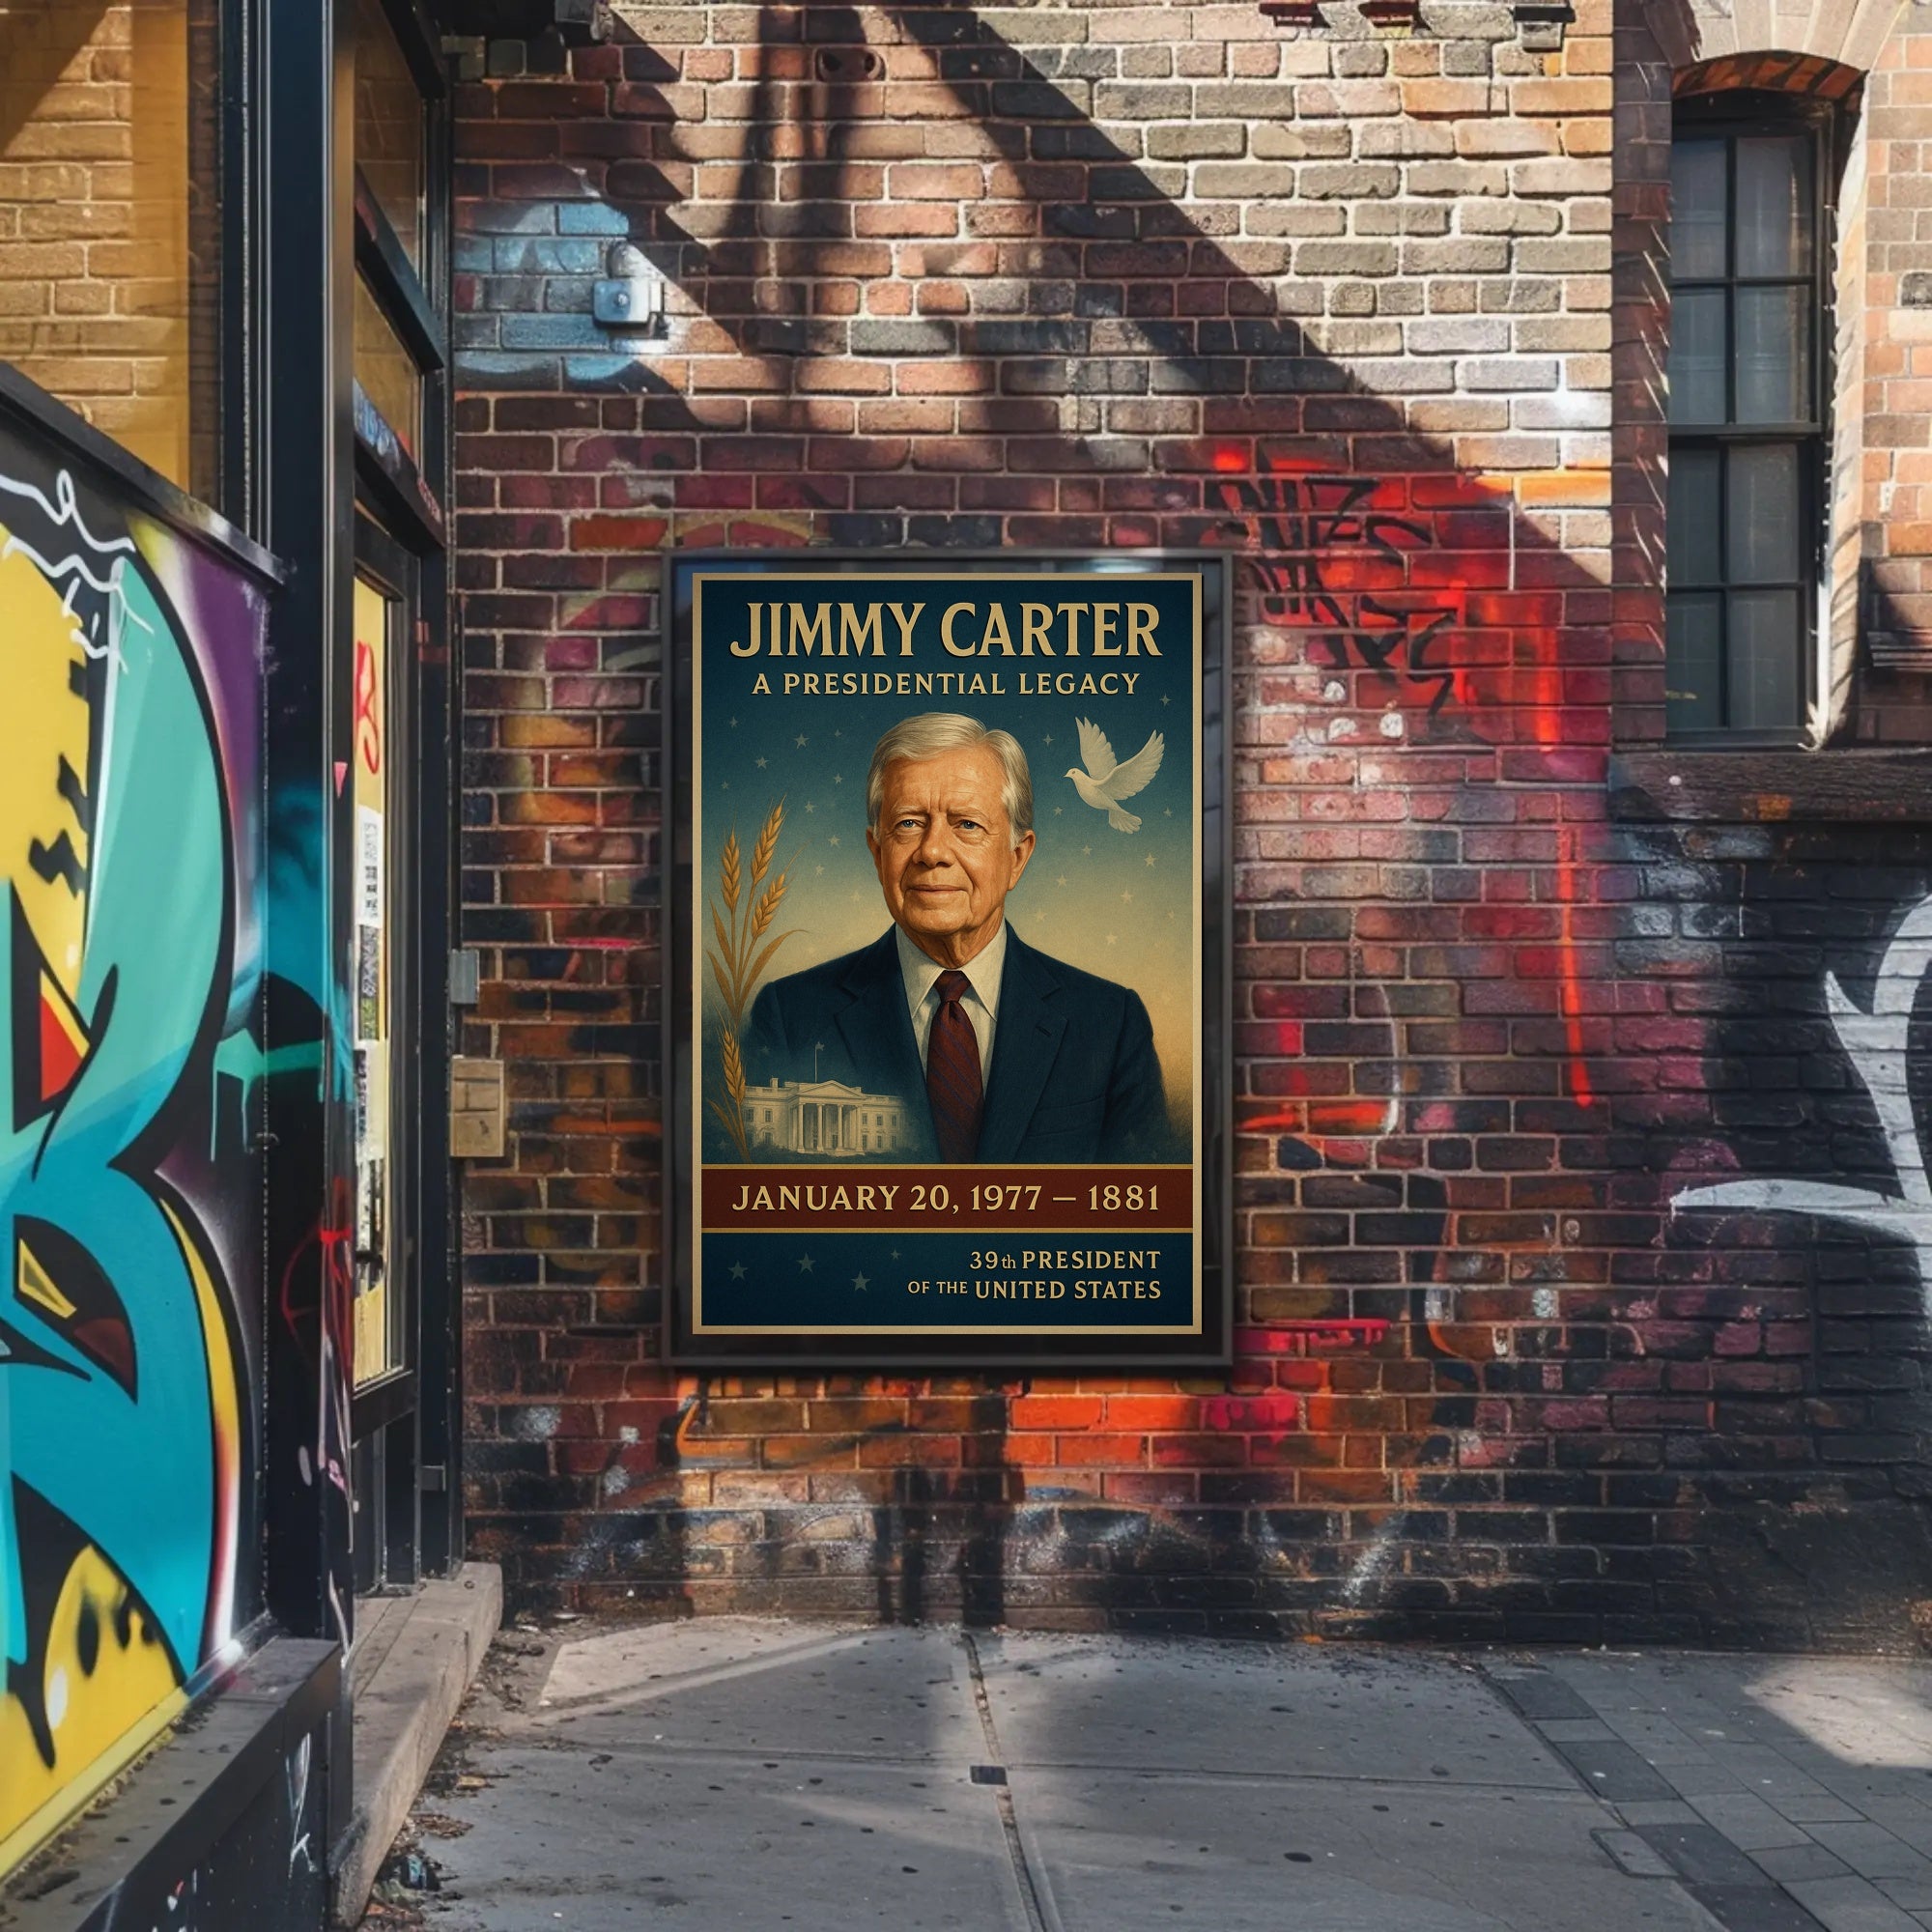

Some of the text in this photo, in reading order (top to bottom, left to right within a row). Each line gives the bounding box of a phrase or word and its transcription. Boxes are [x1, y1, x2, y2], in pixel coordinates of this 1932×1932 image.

[729, 602, 1163, 658] JIMMY CARTER
[751, 672, 1141, 696] A PRESIDENTIAL LEGACY
[731, 1184, 900, 1211] JANUARY
[909, 1184, 959, 1215] 20,
[970, 1184, 1042, 1211] 1977
[1088, 1184, 1159, 1211] 1881
[1022, 1250, 1161, 1269] PRESIDENT
[907, 1280, 1161, 1299] OF THE UNITED STATES
